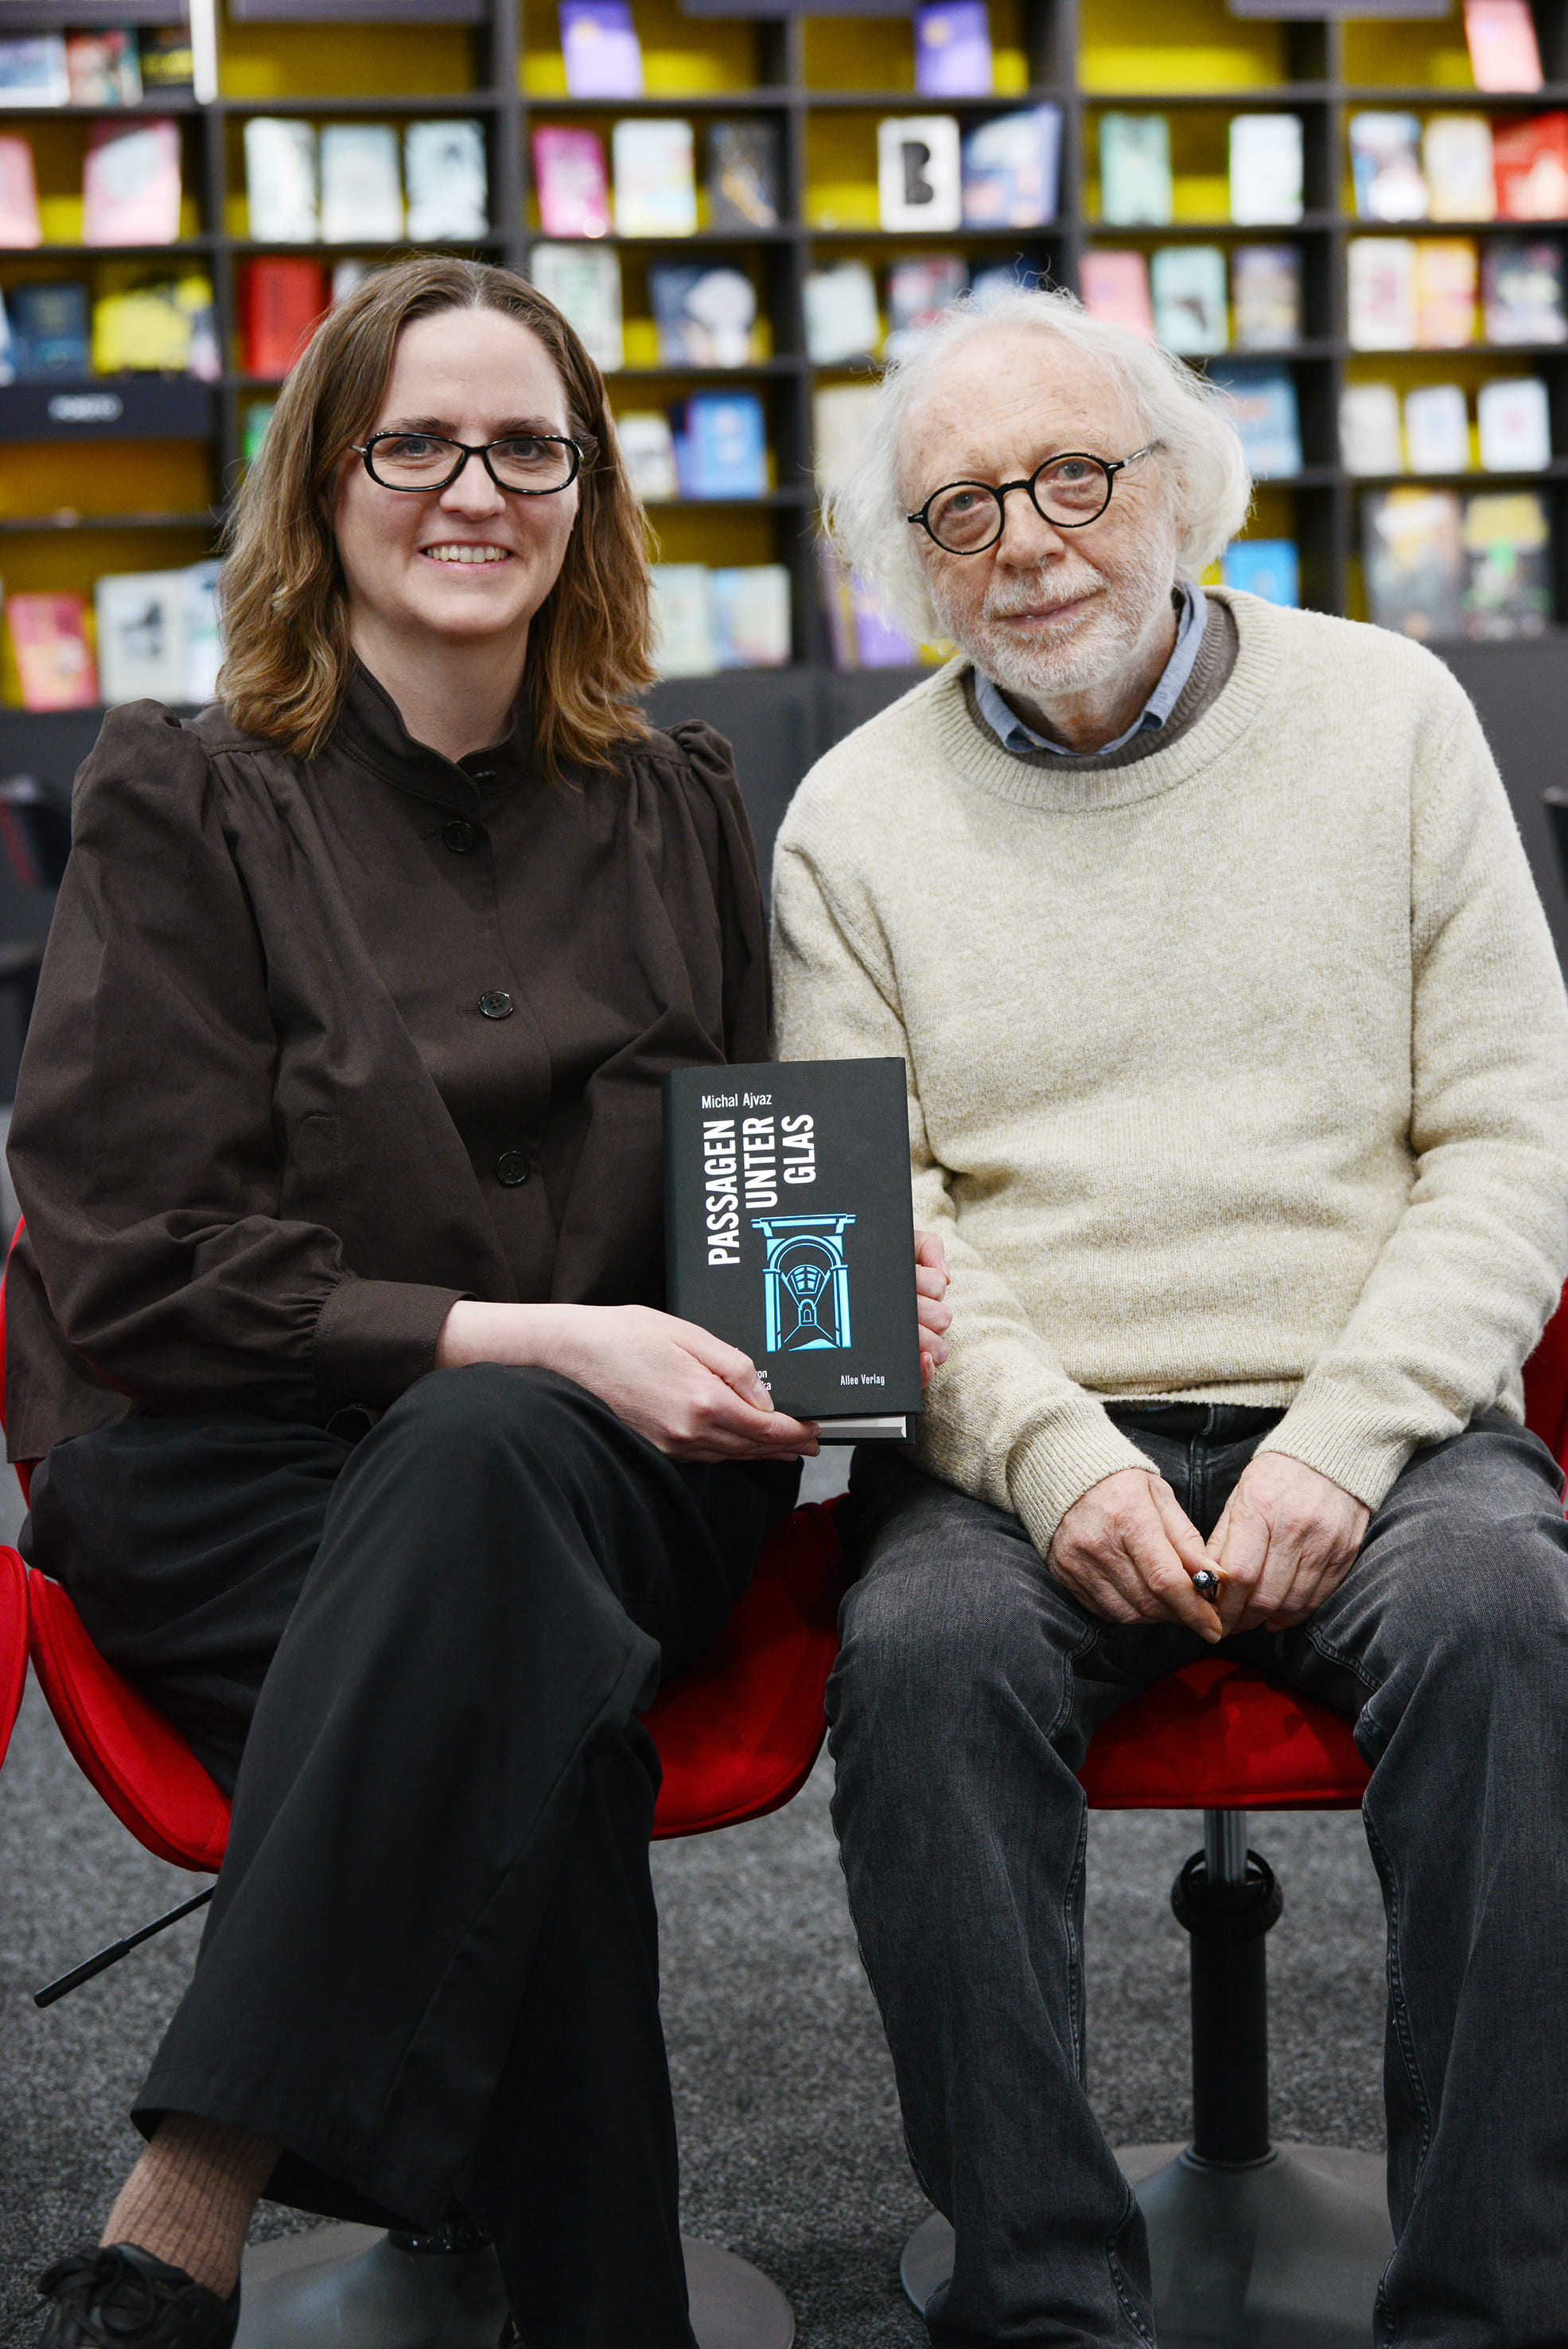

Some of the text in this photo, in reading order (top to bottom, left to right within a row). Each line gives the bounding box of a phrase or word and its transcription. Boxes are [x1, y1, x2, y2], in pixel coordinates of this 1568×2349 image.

[902, 142, 934, 204] B
[701, 1092, 772, 1109] Michal Ajvaz
[743, 1116, 777, 1209] UNTER
[781, 1114, 816, 1184] GLAS
[703, 1119, 741, 1266] PASSAGEN
[840, 1374, 885, 1386] Allee Verlag
